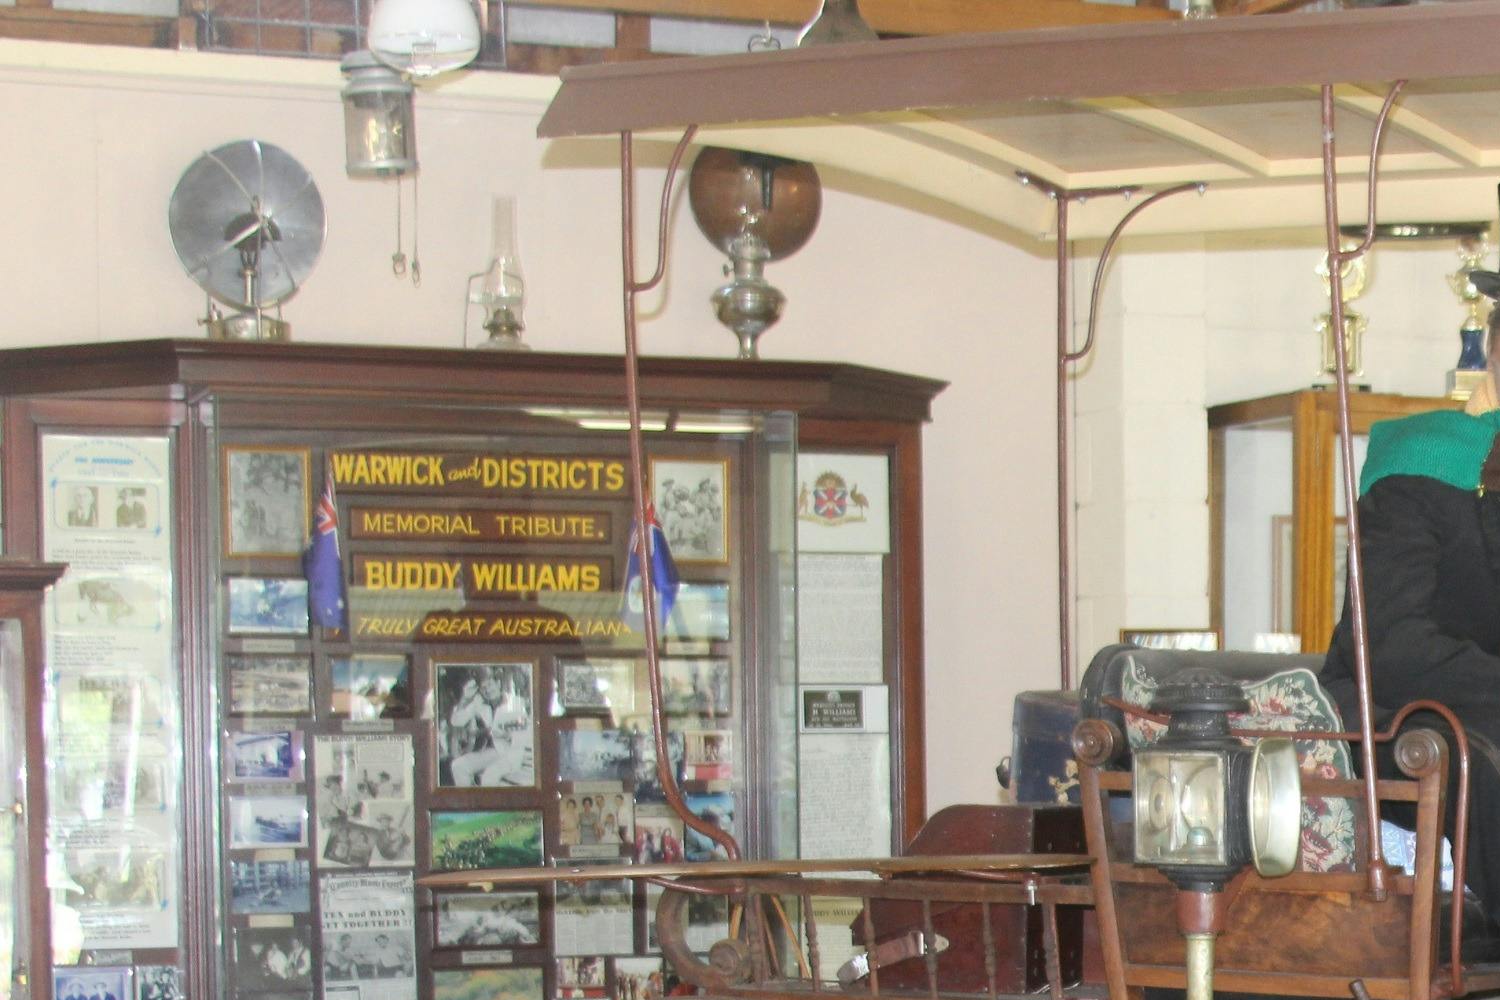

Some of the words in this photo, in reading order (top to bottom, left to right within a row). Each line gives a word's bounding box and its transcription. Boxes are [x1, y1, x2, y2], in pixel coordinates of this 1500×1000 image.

[333, 453, 445, 487] WARWICK
[448, 456, 482, 483] and
[483, 457, 625, 491] DISTRICTS
[363, 512, 480, 536] MEMORIAL
[496, 515, 605, 539] TRIBUTE.
[365, 560, 462, 591] BUDDY
[472, 562, 601, 593] WILLIAMS
[356, 616, 419, 636] TRULY
[422, 617, 486, 637] GREAT
[369, 909, 406, 917] BUDDY
